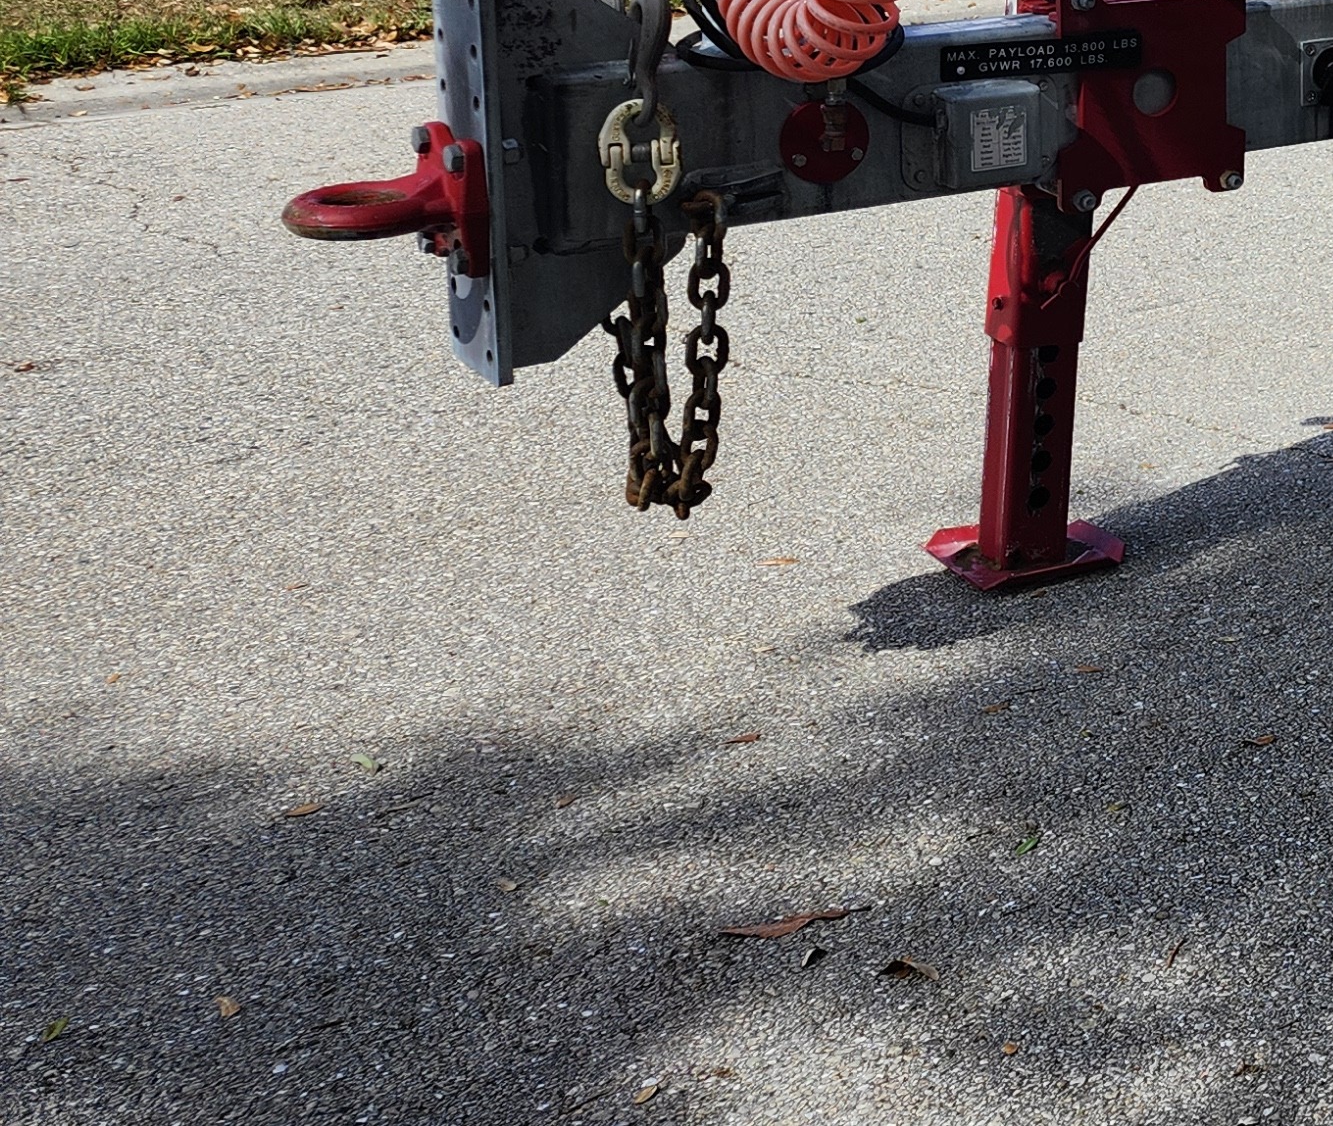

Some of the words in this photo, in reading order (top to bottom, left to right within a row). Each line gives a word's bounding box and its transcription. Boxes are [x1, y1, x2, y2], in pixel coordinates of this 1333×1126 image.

[946, 50, 980, 62] MAX.
[988, 45, 1055, 59] PAYLOAD
[978, 60, 1021, 73] GVWR
[1080, 54, 1108, 65] LBS.
